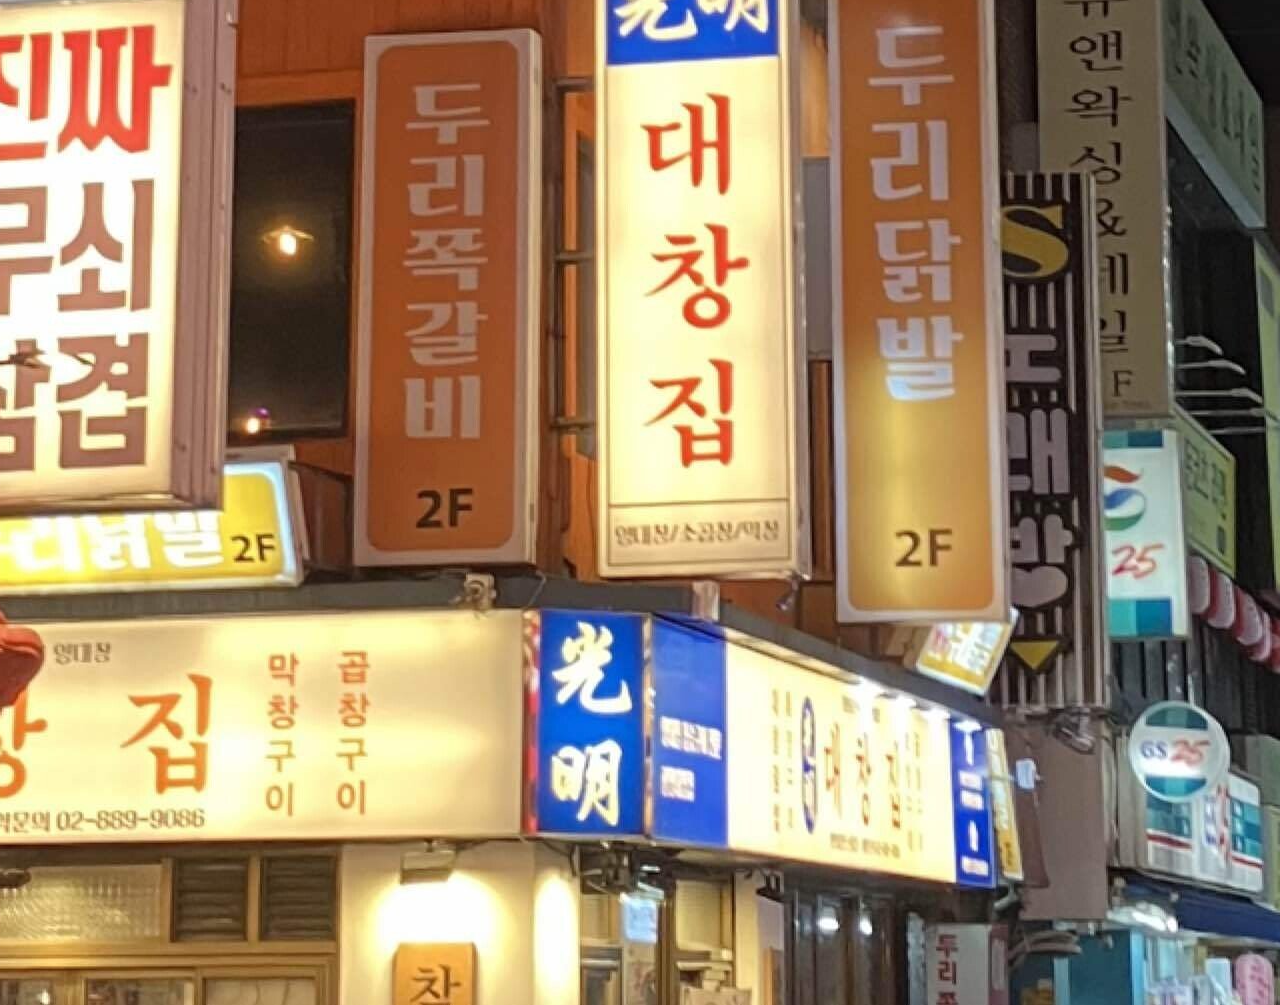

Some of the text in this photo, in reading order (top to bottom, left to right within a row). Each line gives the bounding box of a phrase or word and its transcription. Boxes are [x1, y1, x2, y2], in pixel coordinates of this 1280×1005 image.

[402, 83, 492, 442] 두리쪽갈비
[639, 92, 751, 470] 대창집
[867, 25, 964, 404] 두리닭발
[231, 532, 278, 564] 2F
[414, 488, 475, 531] 2F
[894, 527, 954, 570] 2F
[1111, 542, 1165, 580] 25
[265, 652, 301, 818] 막창구이
[336, 650, 371, 816] 곱창구이
[550, 620, 634, 828] 光明
[56, 808, 206, 832] 02-889-9086
